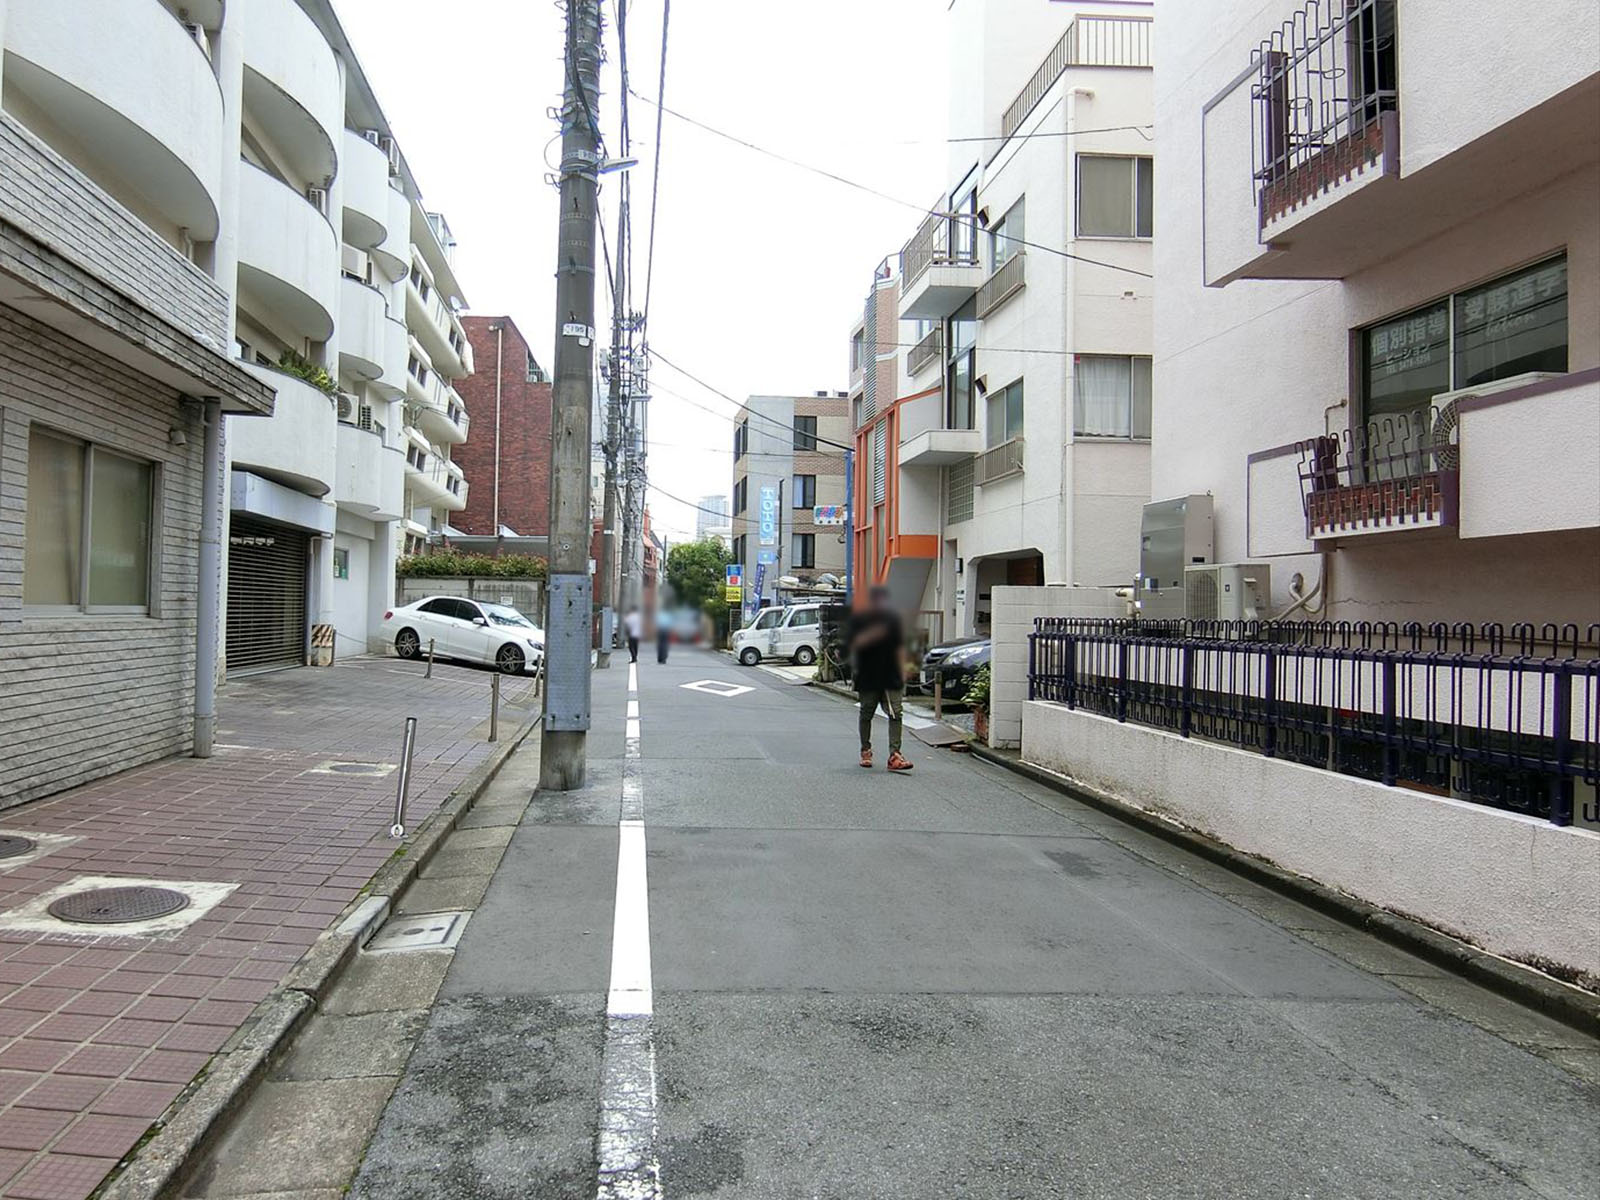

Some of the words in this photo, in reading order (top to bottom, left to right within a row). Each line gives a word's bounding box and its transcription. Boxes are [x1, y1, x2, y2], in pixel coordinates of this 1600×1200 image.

[1372, 312, 1446, 357] 個別指導
[761, 488, 774, 533] TOTO
